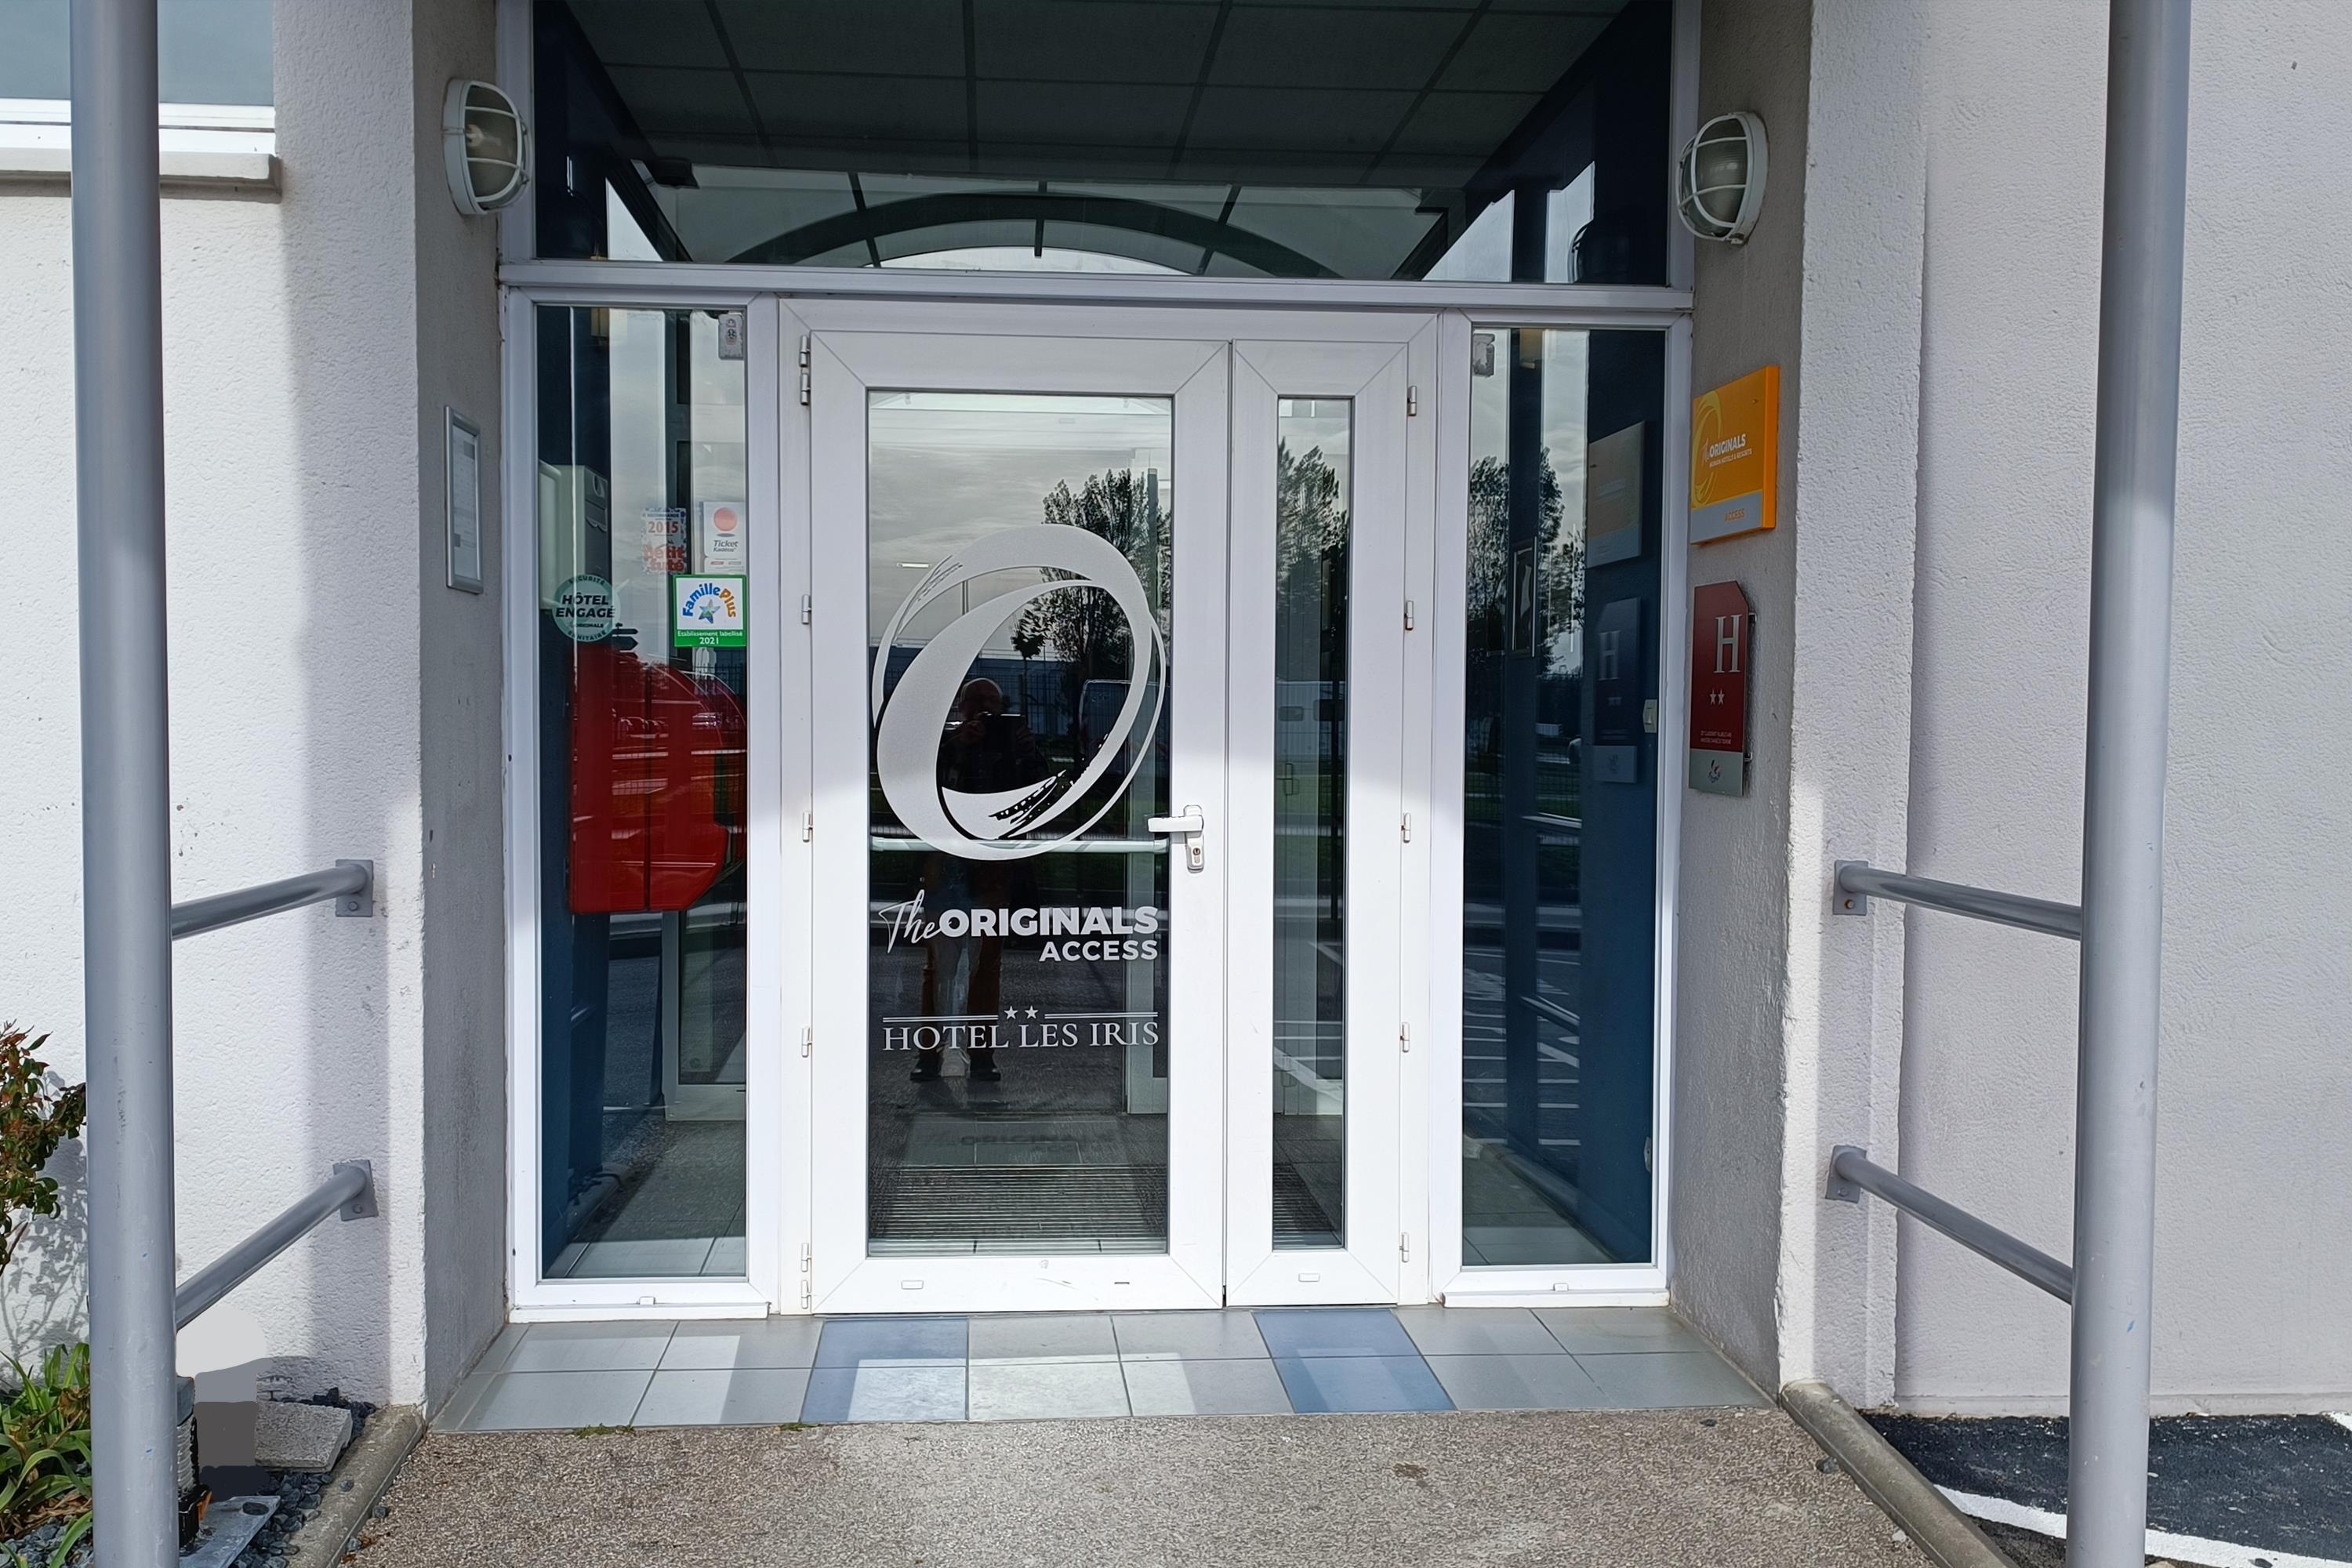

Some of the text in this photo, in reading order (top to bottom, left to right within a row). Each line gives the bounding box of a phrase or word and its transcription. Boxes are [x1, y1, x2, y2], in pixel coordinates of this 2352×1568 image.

[1709, 433, 1747, 458] ORIGINALS
[648, 521, 679, 534] 2015
[713, 539, 739, 548] Ticket
[562, 592, 609, 605] HÔTEL
[682, 583, 720, 617] Famille
[556, 605, 616, 619] ENGAGÉ
[699, 637, 719, 645] 2021
[1714, 615, 1742, 673] H
[878, 888, 1160, 954] The ORIGINALS
[1039, 940, 1159, 963] ACCESS
[882, 1022, 1160, 1051] HOTEL LES IRIS
